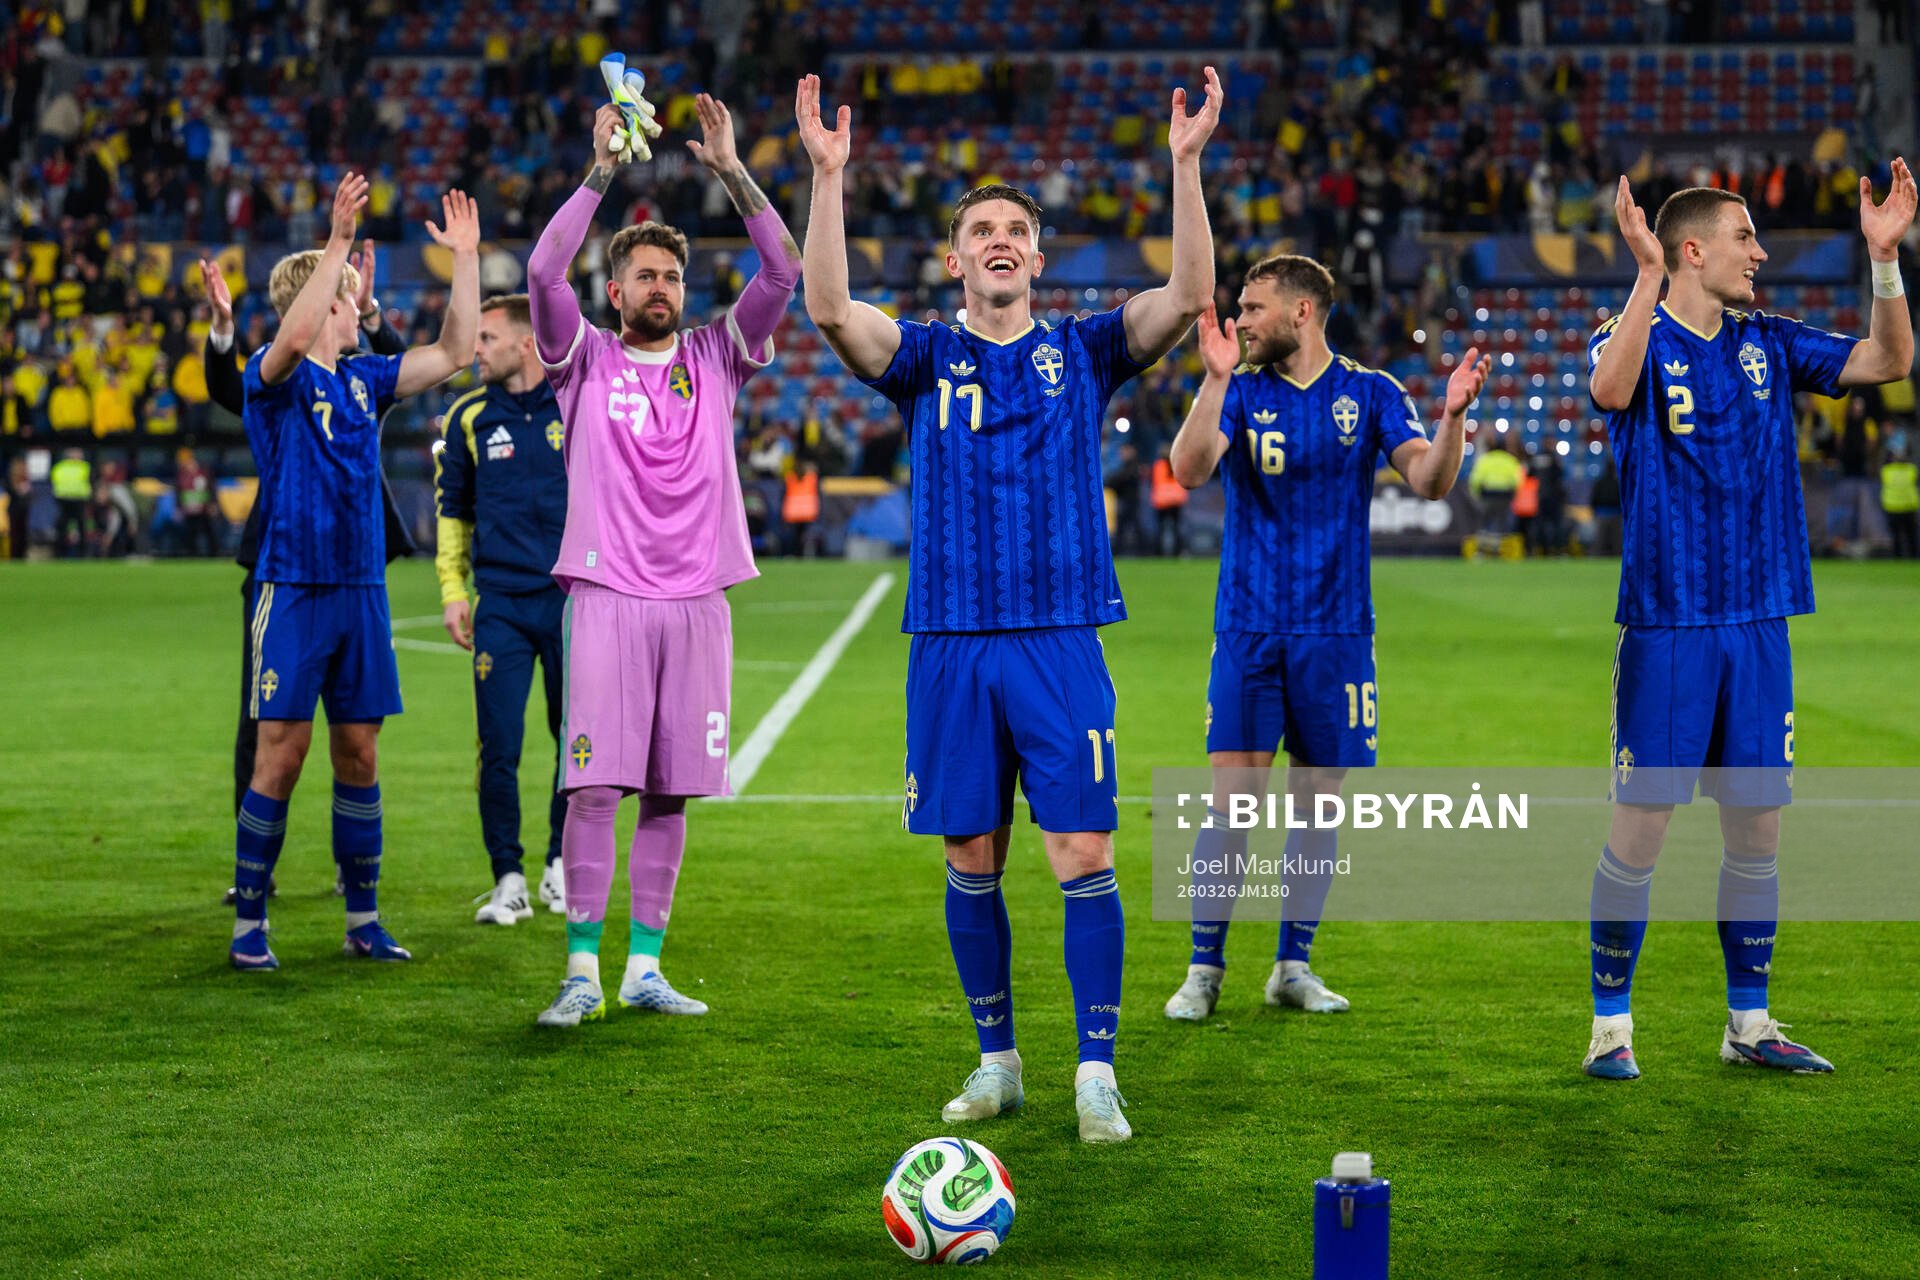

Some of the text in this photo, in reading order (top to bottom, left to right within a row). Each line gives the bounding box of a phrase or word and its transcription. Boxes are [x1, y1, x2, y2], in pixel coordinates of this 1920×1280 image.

[312, 401, 334, 442] 7
[937, 378, 984, 432] 17
[1667, 384, 1695, 436] 2
[1345, 682, 1376, 729] 16
